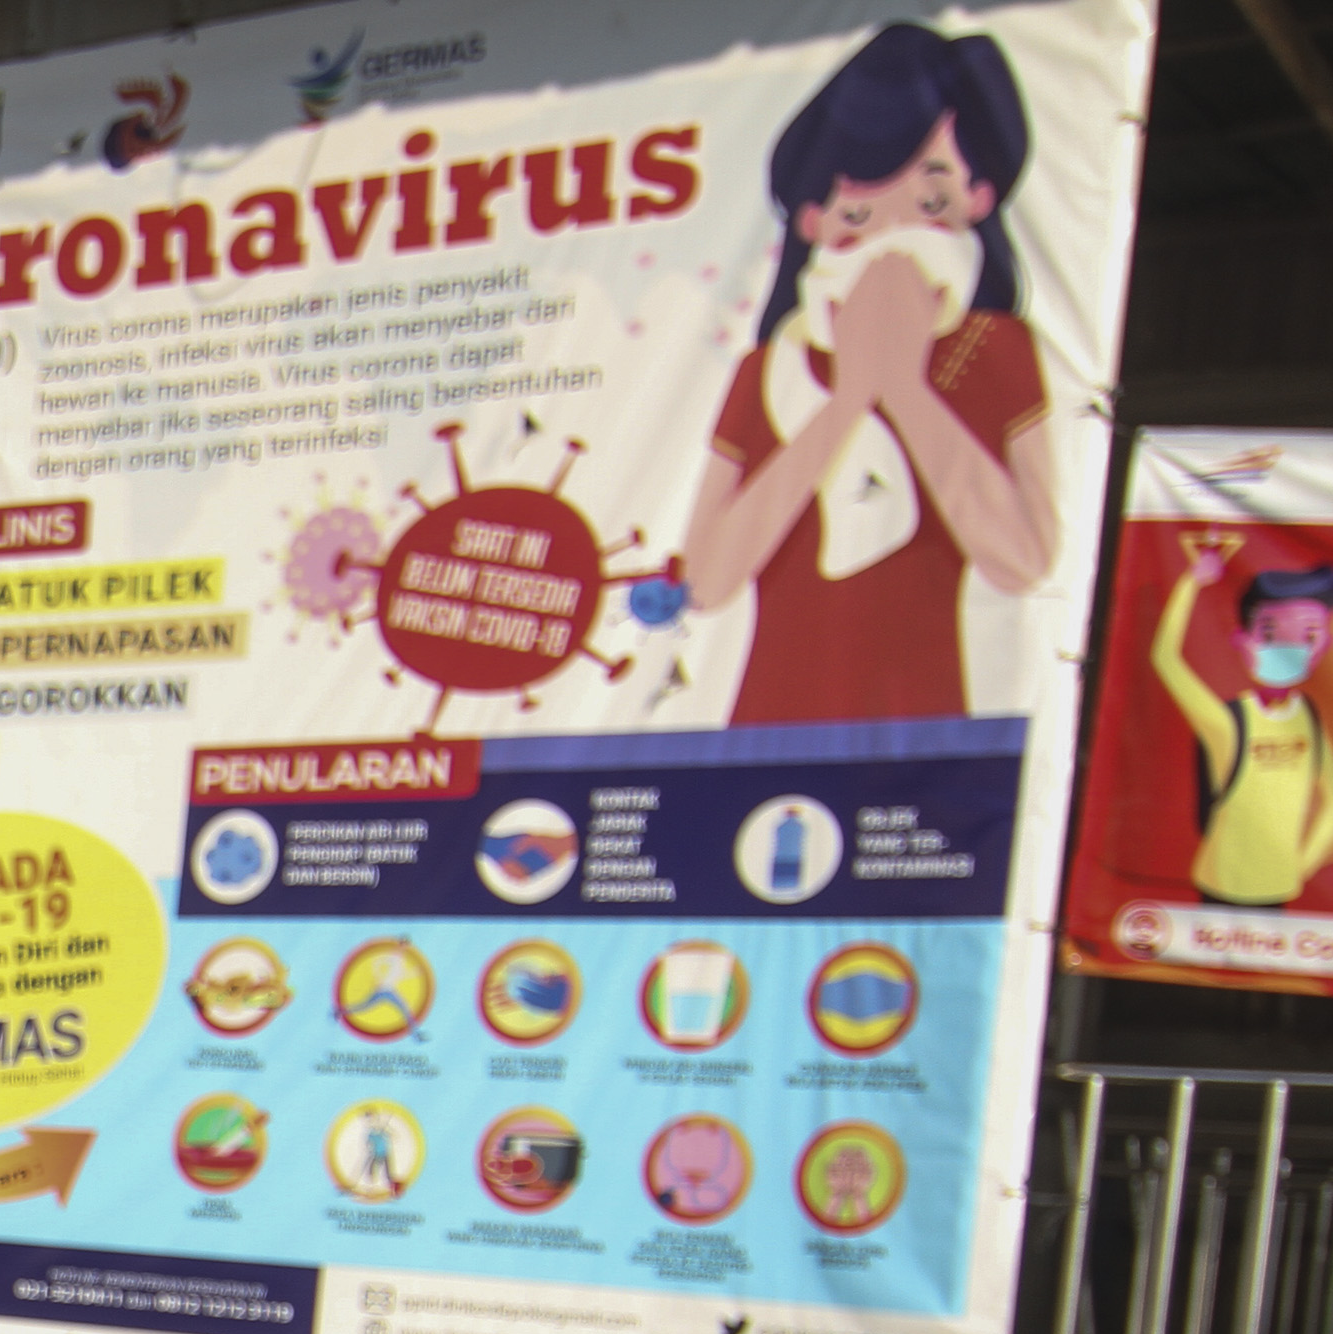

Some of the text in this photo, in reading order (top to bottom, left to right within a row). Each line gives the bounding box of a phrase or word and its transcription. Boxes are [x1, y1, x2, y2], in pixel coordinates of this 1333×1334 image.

[361, 36, 487, 80] GERMAS
[42, 263, 530, 349] Virus corona merupakan jenis penyakit
[159, 340, 239, 369] infeksi
[245, 331, 306, 356] virus
[313, 323, 375, 350] akan
[383, 304, 517, 344] menyebar
[524, 294, 577, 326] dari
[39, 386, 116, 414] hewan
[122, 379, 151, 406] ke
[273, 360, 341, 388] Virus
[346, 353, 440, 381] corona
[448, 336, 525, 372] dapat
[38, 365, 604, 451] menyebar jika seseorang saling bersentuhan
[33, 422, 390, 483] dengan orang yang terinfeksi
[452, 518, 553, 570] SAAT INI
[103, 568, 215, 605] PILEK
[399, 552, 583, 617] BELUM TERSEDIA
[0, 620, 239, 663] PERNAPASAN
[386, 590, 573, 659] VAKSIN COVID-19
[196, 747, 452, 795] PENULARAN
[14, 939, 60, 967] Diri
[64, 933, 110, 958] dan
[12, 965, 103, 996] dengan
